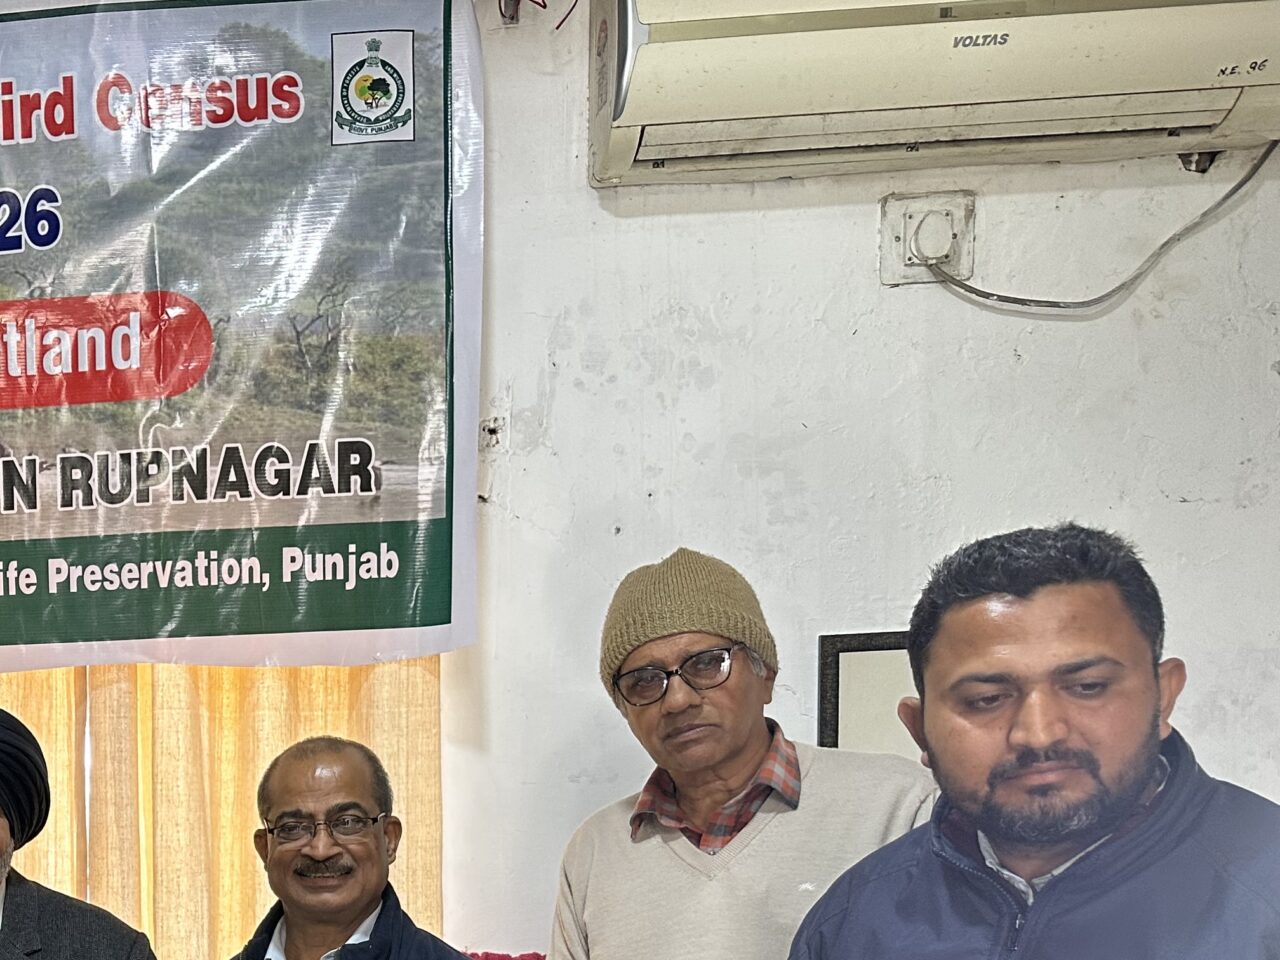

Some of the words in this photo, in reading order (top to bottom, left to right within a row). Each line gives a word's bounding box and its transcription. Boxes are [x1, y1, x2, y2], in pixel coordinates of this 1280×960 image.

[953, 33, 1009, 48] VOLTAS
[56, 437, 378, 510] RUPNAGAR
[47, 550, 271, 594] Preservation,
[281, 541, 400, 590] Punjab
